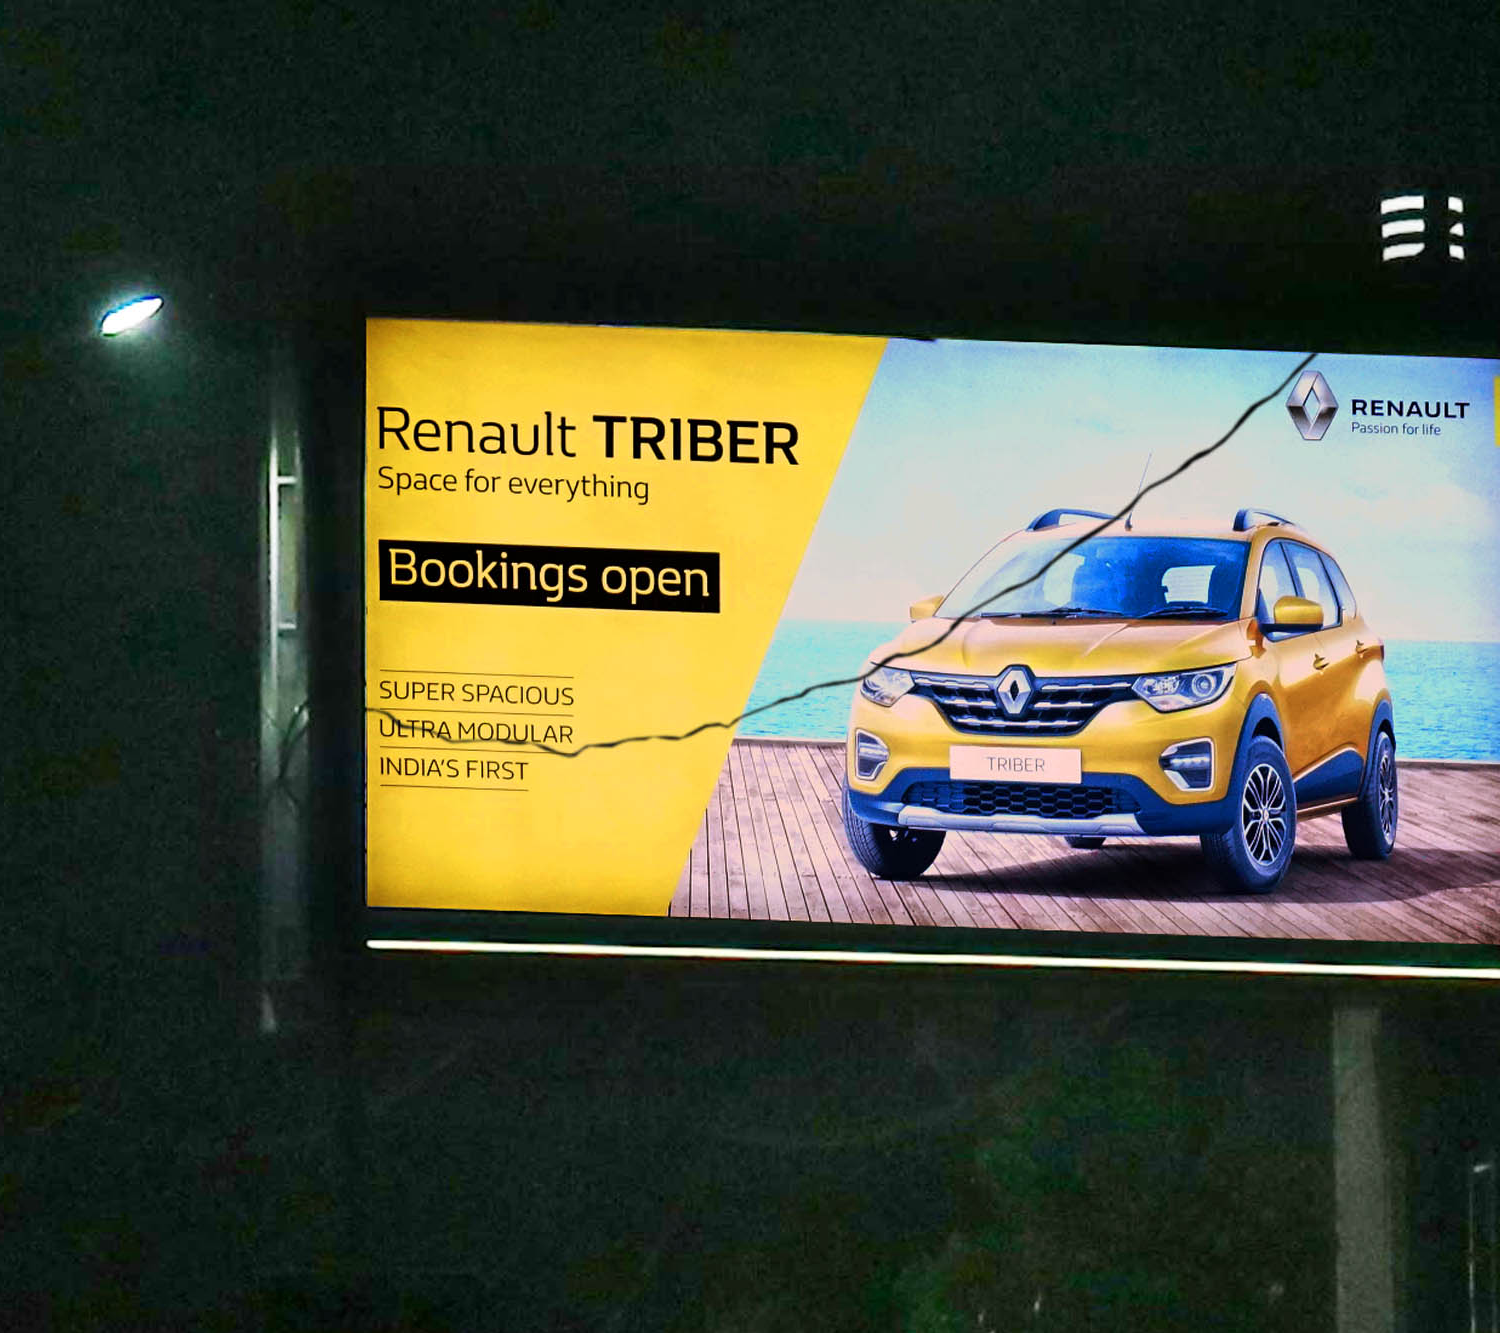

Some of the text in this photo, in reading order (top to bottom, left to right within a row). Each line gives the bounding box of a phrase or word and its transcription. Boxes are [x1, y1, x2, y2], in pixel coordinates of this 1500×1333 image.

[1352, 399, 1470, 418] RENAULT
[376, 406, 799, 466] Renault TRIBER
[1351, 421, 1441, 436] Passion for life
[378, 466, 650, 506] Space for everything
[388, 548, 710, 605] Bookings open
[379, 680, 575, 706] SUPER SPACIOUS
[379, 718, 574, 744] ULTRA MODULAR
[379, 756, 530, 781] INDIA'S FIRST
[987, 757, 1045, 772] TRIBER
